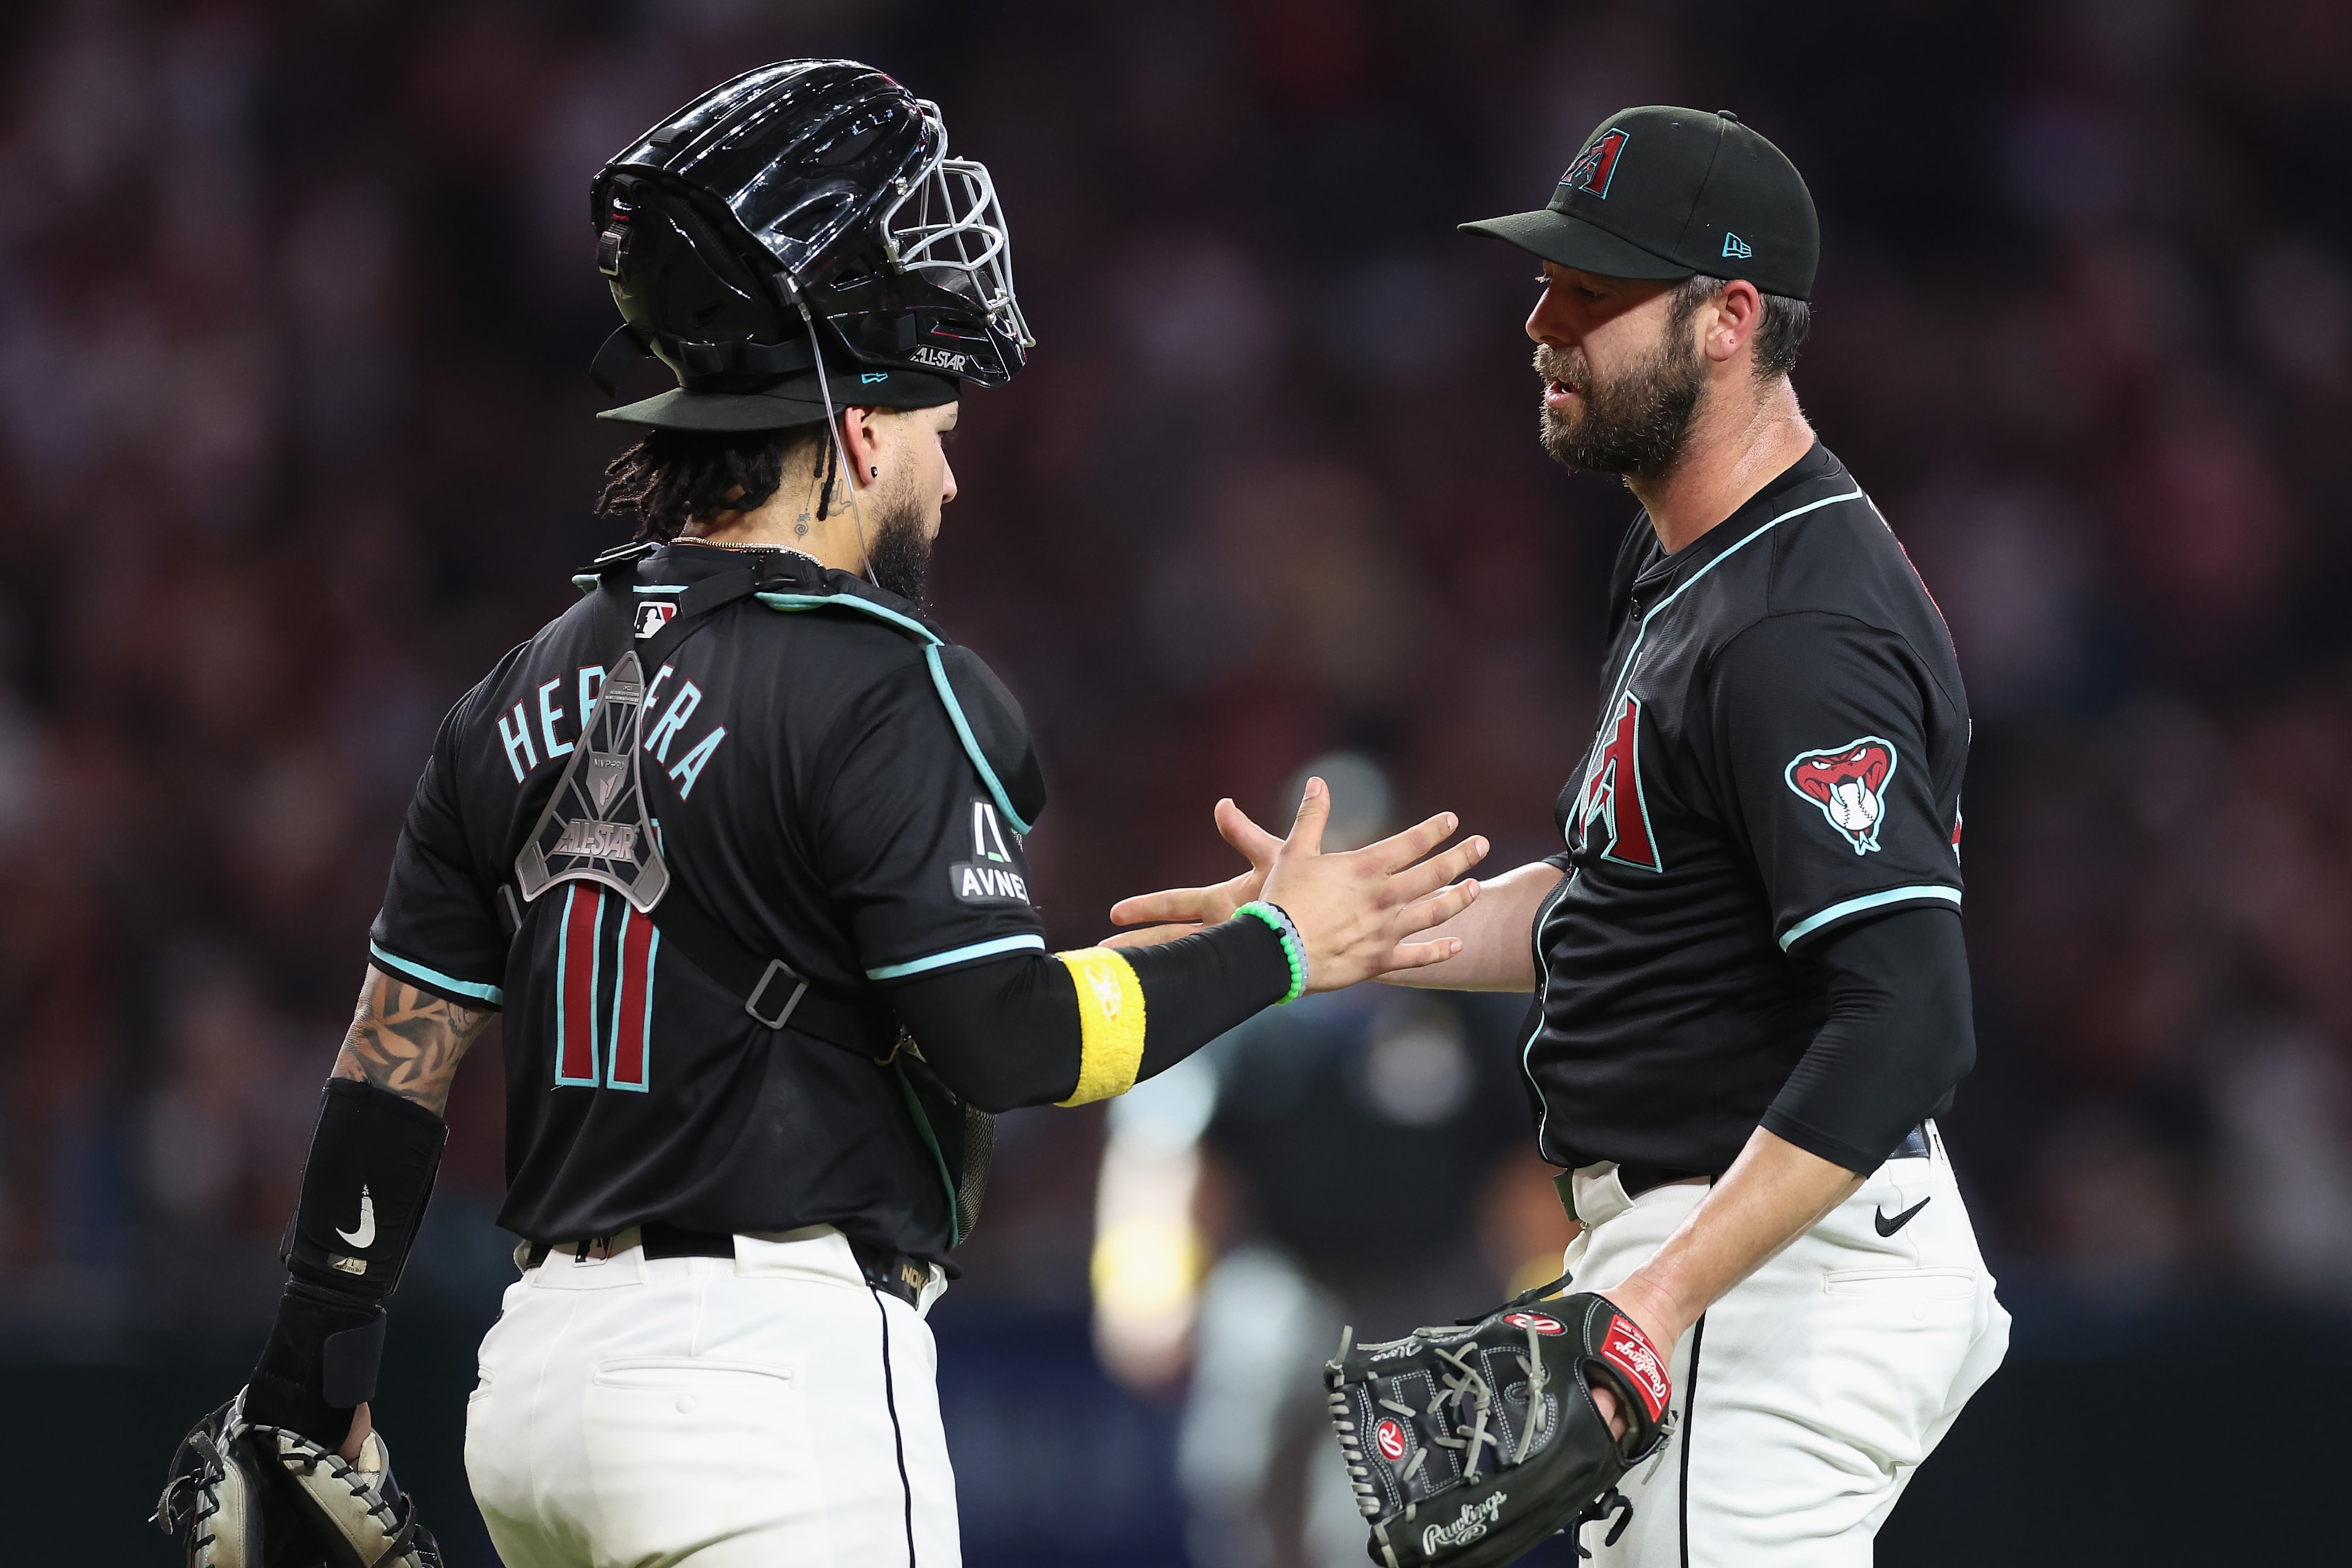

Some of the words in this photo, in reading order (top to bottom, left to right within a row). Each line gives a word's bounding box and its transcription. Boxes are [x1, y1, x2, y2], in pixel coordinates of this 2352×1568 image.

[910, 346, 966, 372] ALL-STAR
[496, 662, 728, 802] HERERA
[553, 820, 634, 859] ALL-STAR
[555, 818, 662, 1093] 11
[1613, 1341, 1667, 1398] Rawlings
[1422, 1490, 1508, 1556] Rawlings
